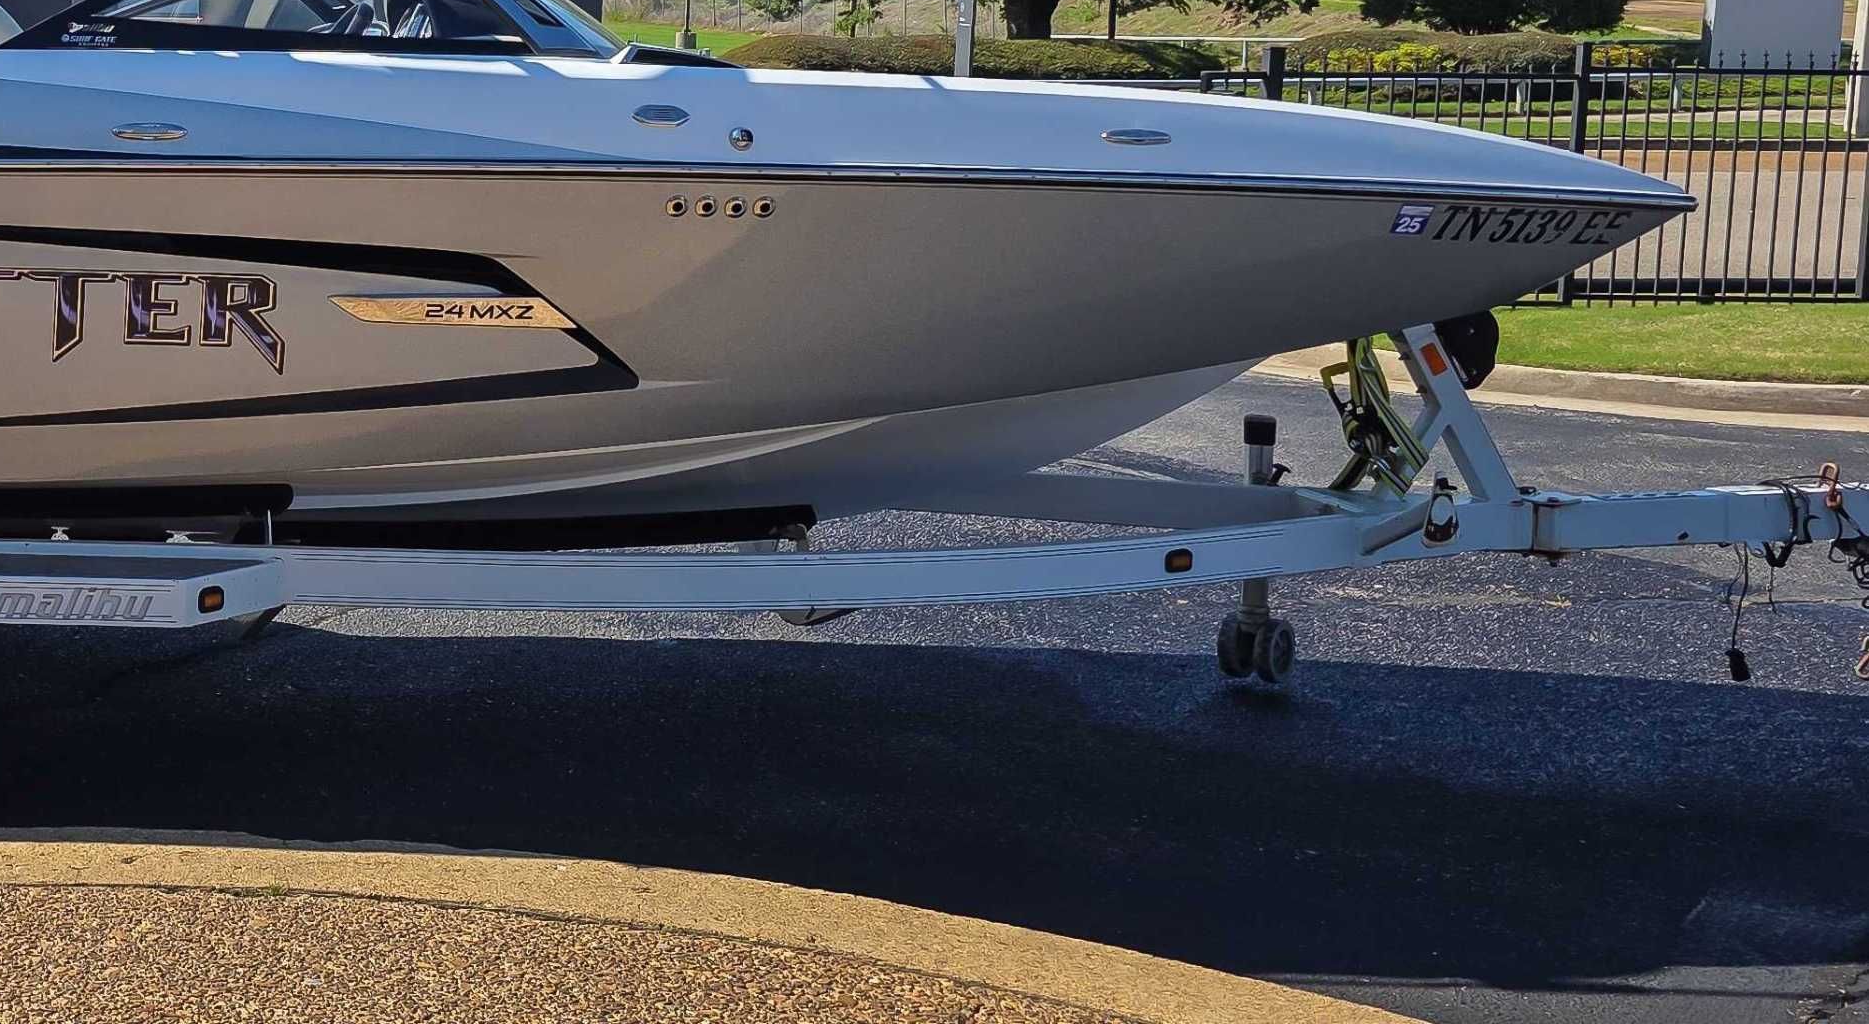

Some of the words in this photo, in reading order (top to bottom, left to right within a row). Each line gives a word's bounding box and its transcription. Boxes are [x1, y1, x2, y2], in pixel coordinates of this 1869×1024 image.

[1394, 216, 1425, 233] 25
[1432, 205, 1498, 242] TN
[1488, 207, 1580, 245] 5139
[424, 303, 465, 319] 24
[469, 304, 534, 320] MXZ
